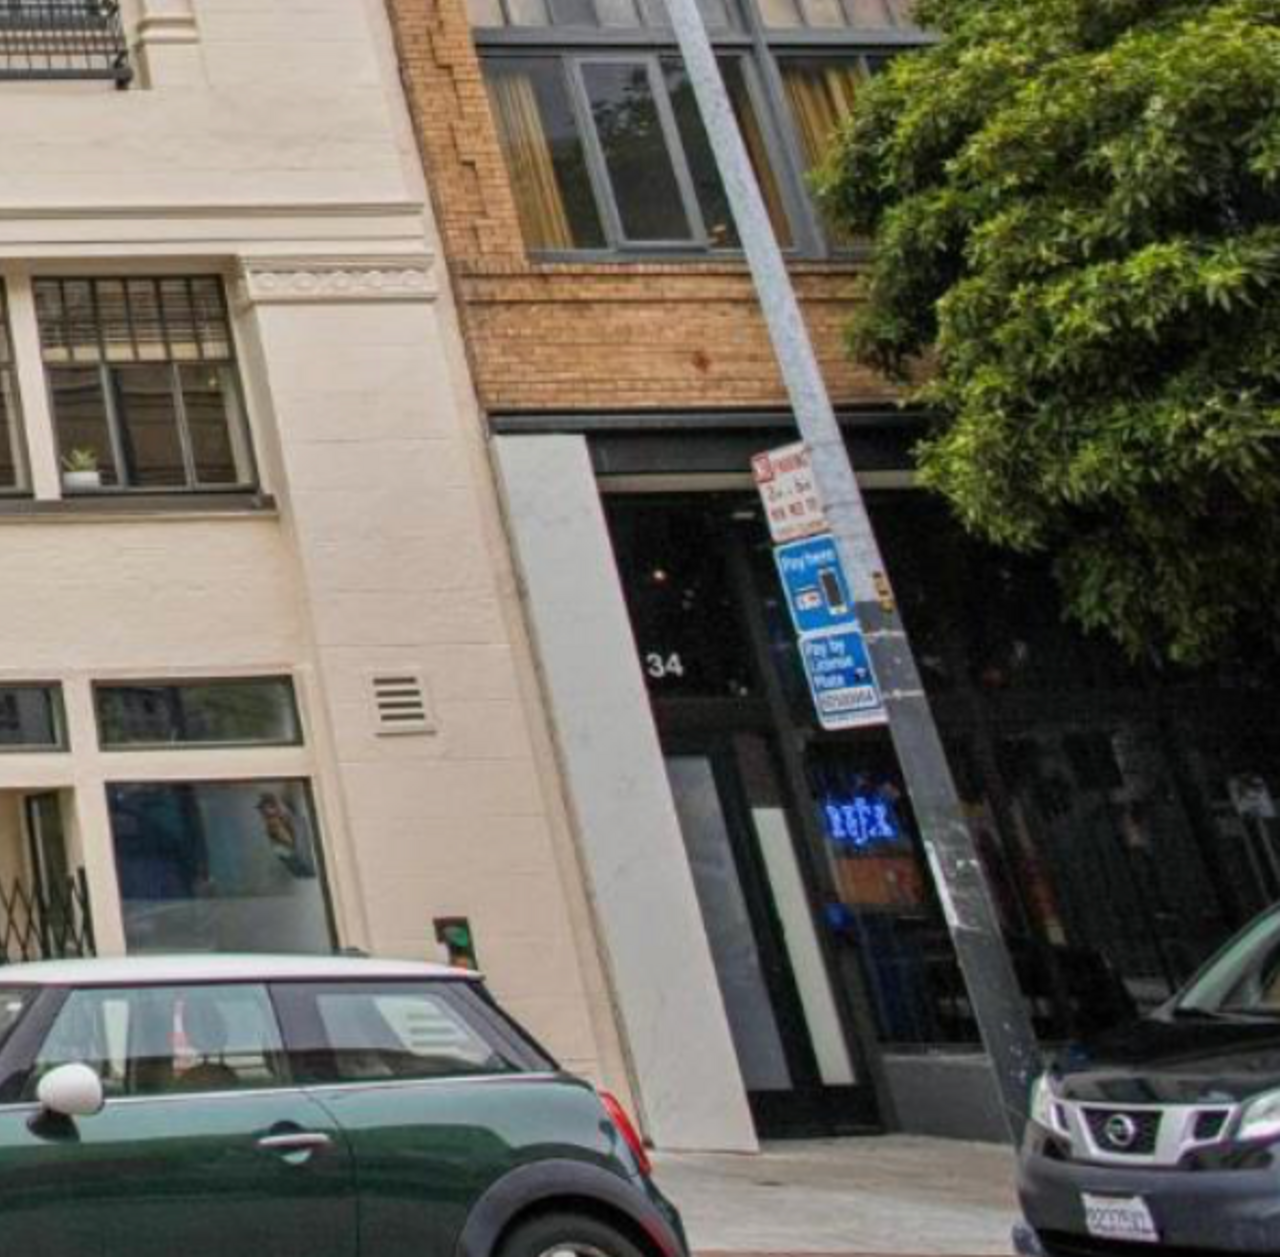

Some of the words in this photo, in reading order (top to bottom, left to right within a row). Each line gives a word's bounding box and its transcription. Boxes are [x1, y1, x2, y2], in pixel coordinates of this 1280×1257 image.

[805, 643, 827, 658] Pay
[829, 640, 846, 654] by
[646, 652, 683, 678] 34
